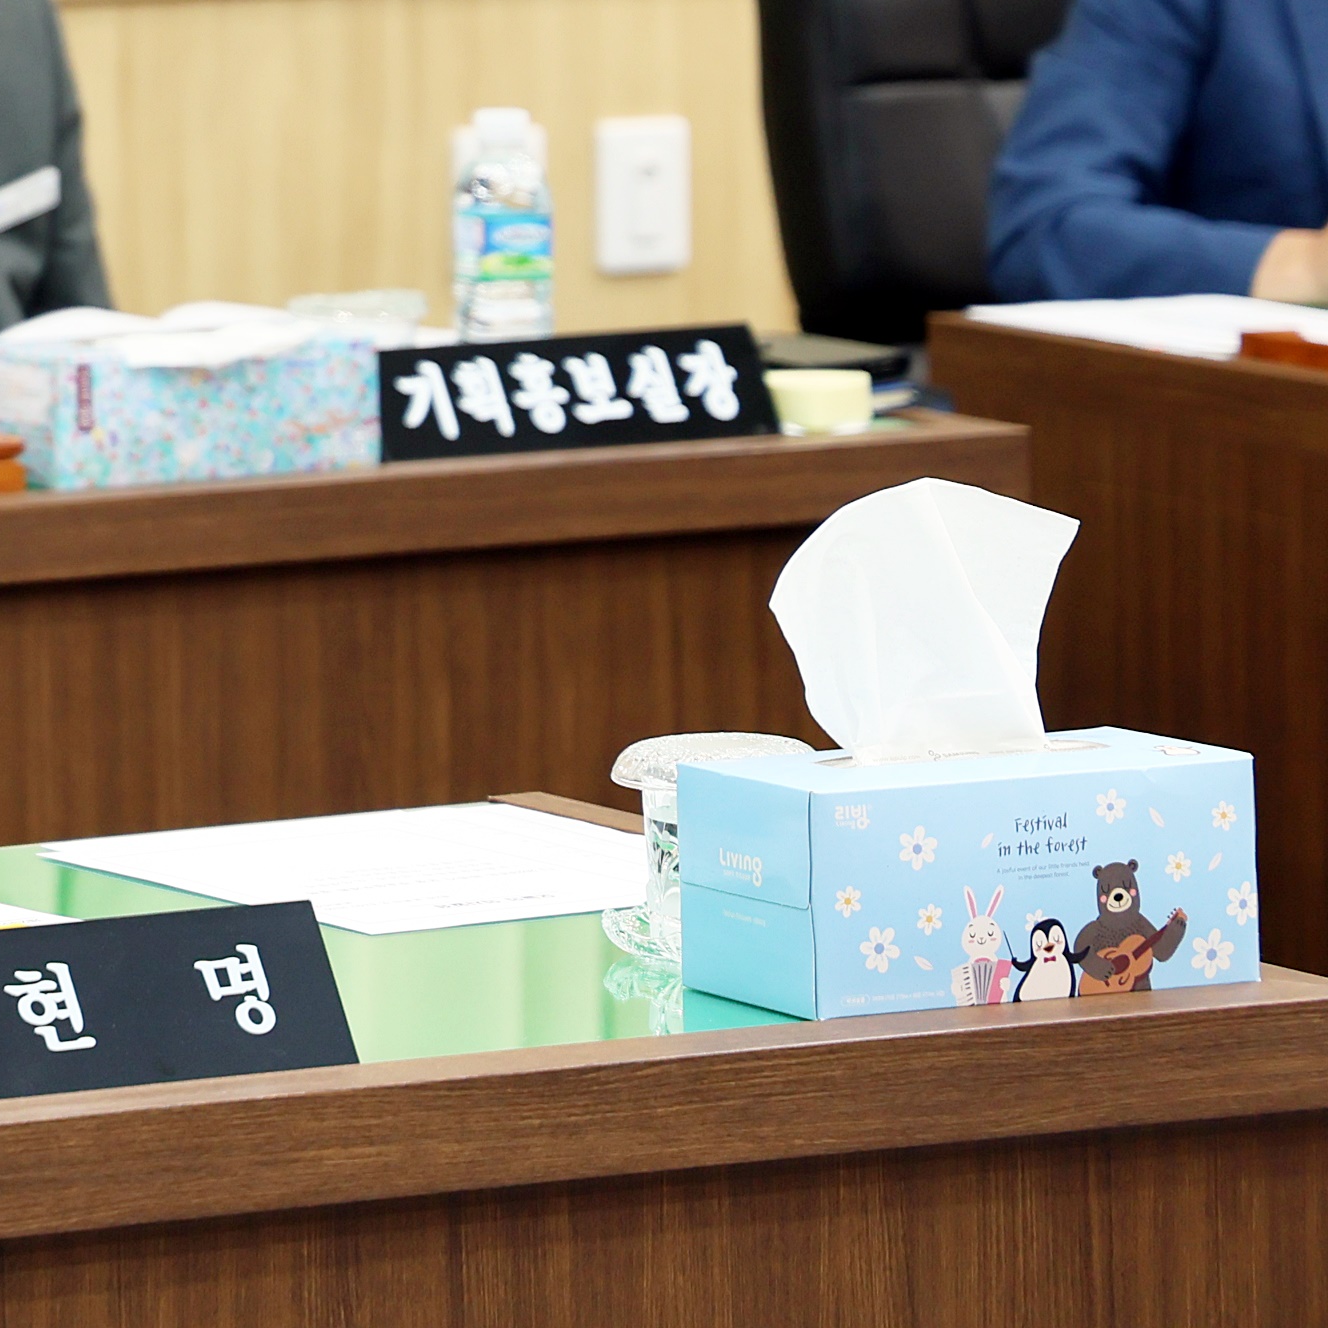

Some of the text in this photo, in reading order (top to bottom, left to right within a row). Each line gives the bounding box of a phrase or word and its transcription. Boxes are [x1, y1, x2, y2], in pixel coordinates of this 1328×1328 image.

[394, 338, 741, 440] 기획홍보실장
[834, 804, 871, 829] 리빙
[1014, 811, 1068, 835] Festival
[997, 835, 1088, 858] in the forest
